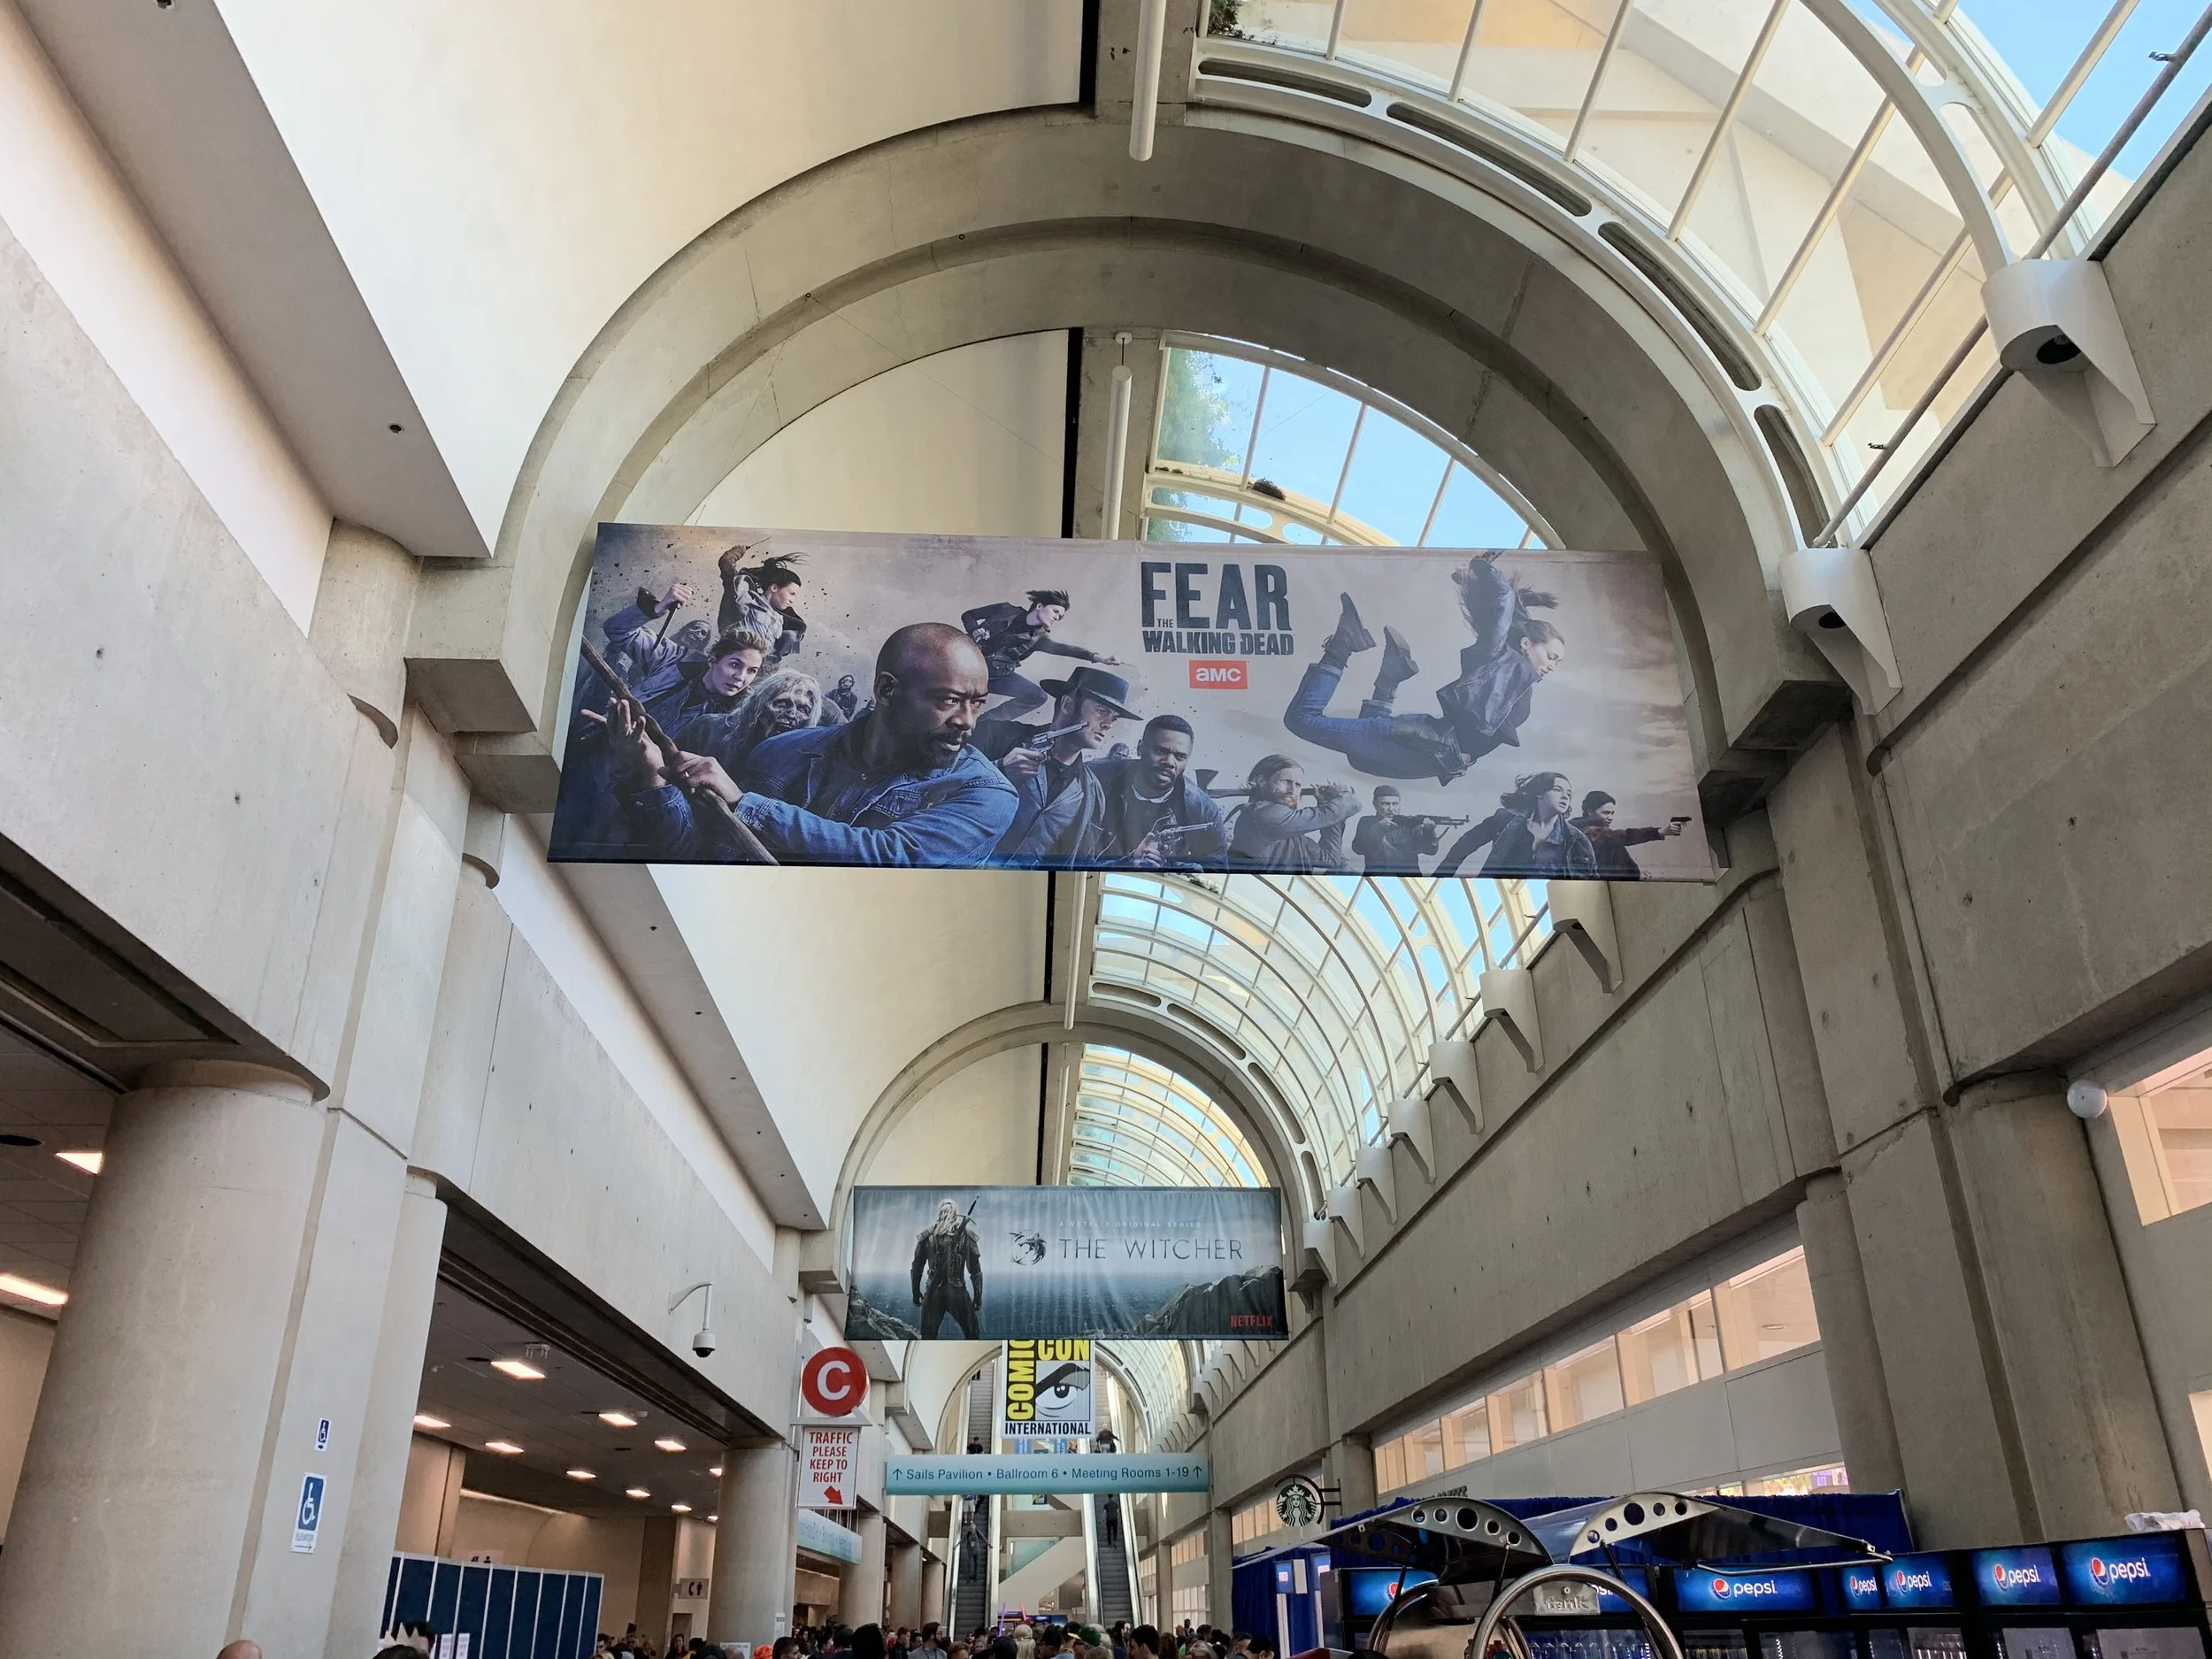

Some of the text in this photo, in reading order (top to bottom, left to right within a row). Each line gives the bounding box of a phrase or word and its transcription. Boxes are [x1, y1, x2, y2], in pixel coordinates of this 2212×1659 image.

[1141, 562, 1292, 630] FEAR
[1157, 618, 1173, 628] THE
[1142, 631, 1294, 656] WALKING DEAD
[1059, 1239, 1243, 1260] THE WITCHER
[1230, 1315, 1272, 1327] NETFLIX
[818, 1360, 850, 1401] C
[1005, 1422, 1091, 1434] INTERNATIONAL
[810, 1432, 853, 1444] TRAFFIC
[812, 1446, 847, 1457] PLEASE
[810, 1459, 848, 1470] KEEP TO
[907, 1467, 1189, 1480] Sails Pavilion Ballroom 6 Meeting Rooms 1-19
[813, 1471, 842, 1483] RIGHT
[2008, 1565, 2040, 1587] pepsi
[2109, 1557, 2149, 1584] pepsi
[1733, 1579, 1776, 1598] pepsi
[1859, 1577, 1877, 1597] pepsi
[1907, 1571, 1932, 1592] pepsi
